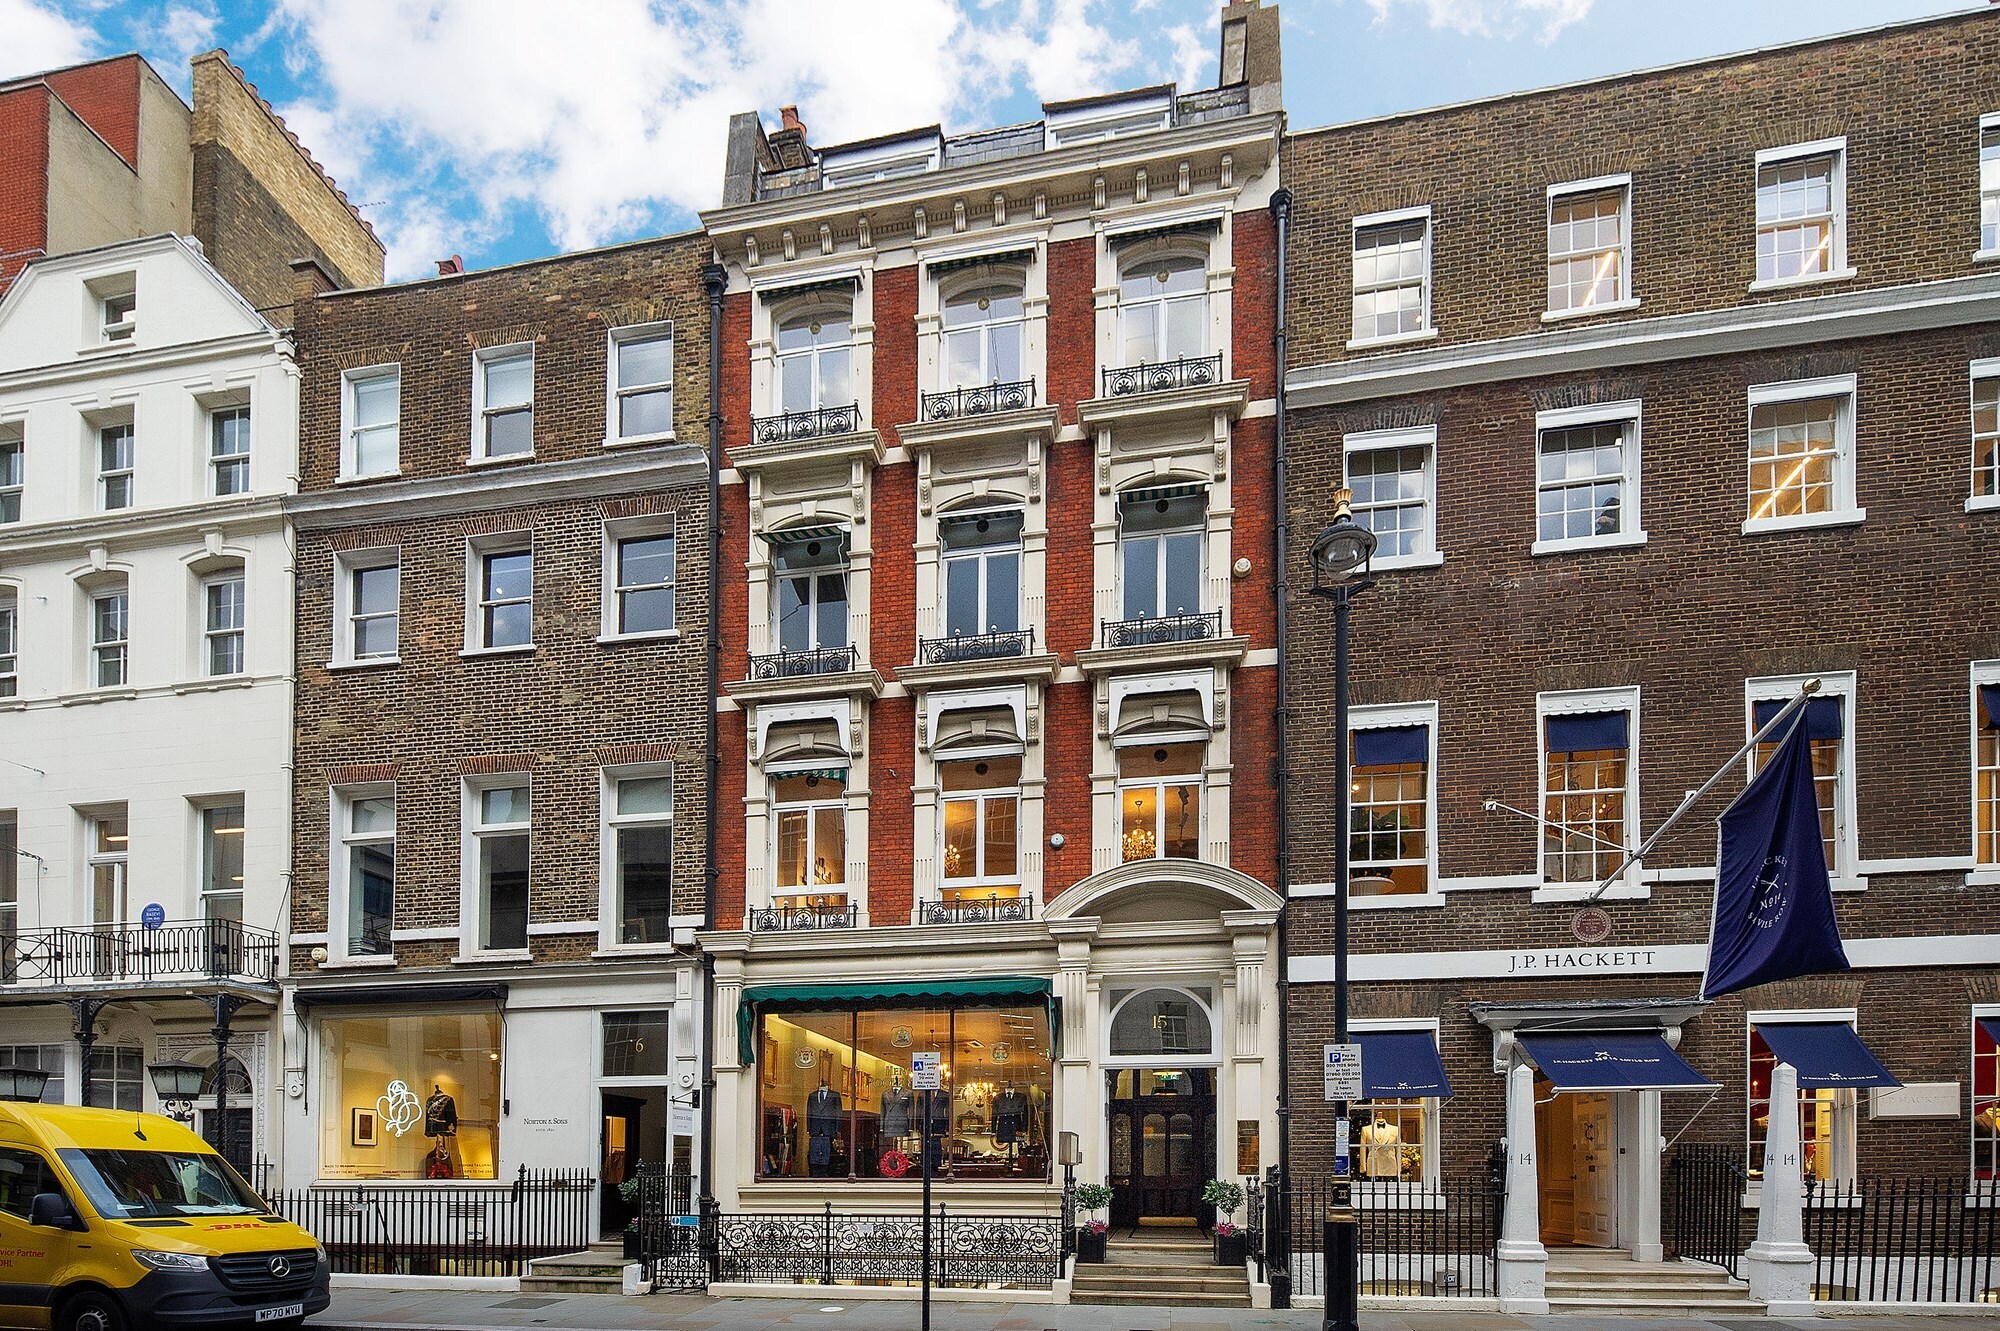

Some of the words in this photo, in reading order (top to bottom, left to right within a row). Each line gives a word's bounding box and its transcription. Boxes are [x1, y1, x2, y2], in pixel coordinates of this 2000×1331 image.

[1508, 955, 1537, 973] J.P.
[1545, 951, 1656, 968] HACKETT
[1153, 1015, 1168, 1028] 15
[636, 1037, 644, 1053] 6
[553, 1117, 569, 1125] SONS
[1520, 1153, 1533, 1165] 14
[1766, 1154, 1775, 1165] 14
[1784, 1153, 1797, 1165] 14
[16, 1249, 46, 1258] Partner
[260, 1308, 284, 1320] WP70
[285, 1305, 300, 1316] MYU
